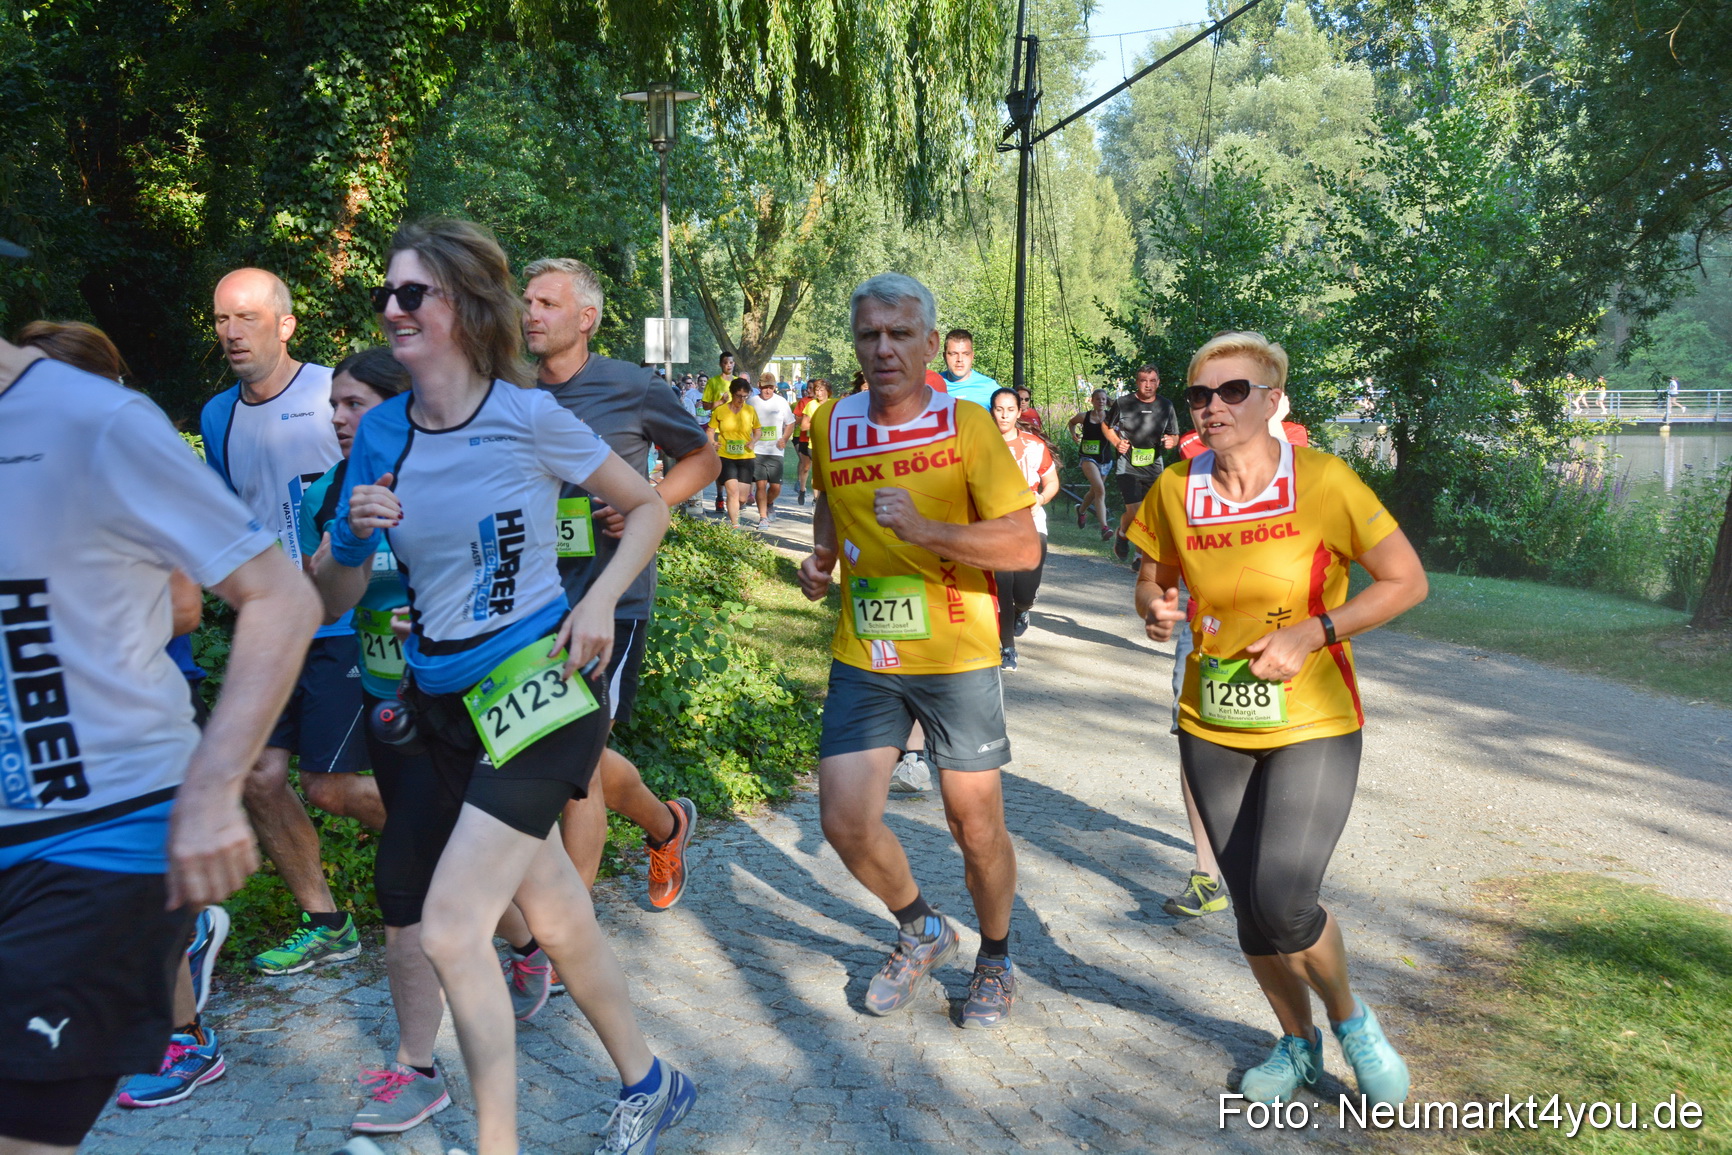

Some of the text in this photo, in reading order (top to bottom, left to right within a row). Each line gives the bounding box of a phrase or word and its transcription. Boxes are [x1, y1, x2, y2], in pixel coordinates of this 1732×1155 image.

[830, 447, 962, 488] MAX BÖGL
[282, 501, 293, 530] WASTE
[1186, 522, 1301, 551] MAX BÖGL
[469, 541, 482, 567] WASTE
[488, 508, 526, 618] HUBER
[858, 598, 914, 621] 1271
[364, 632, 402, 660] 211
[0, 578, 91, 808] HUBER
[487, 669, 568, 739] 2123
[1206, 680, 1271, 707] 1288
[1233, 708, 1256, 716] Margit
